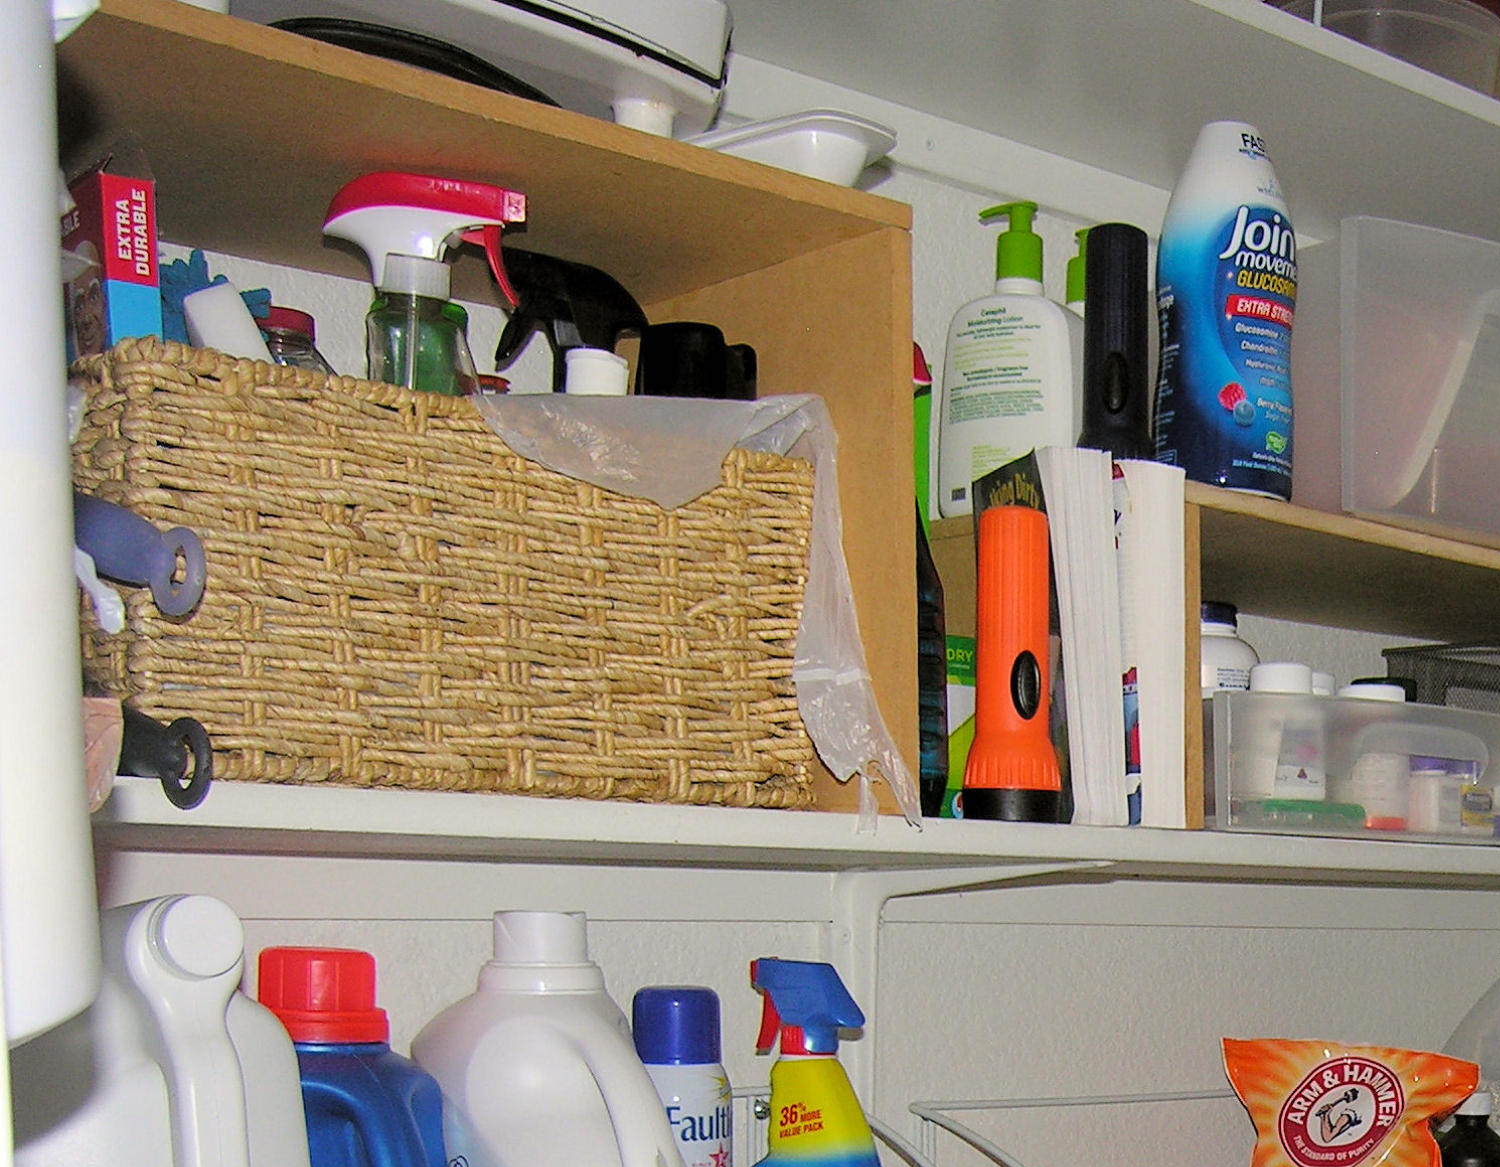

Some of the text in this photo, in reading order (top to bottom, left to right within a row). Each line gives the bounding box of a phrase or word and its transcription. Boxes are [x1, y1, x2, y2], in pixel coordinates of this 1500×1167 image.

[115, 199, 133, 260] EXTRA
[131, 187, 151, 277] DURABLE
[1236, 298, 1271, 315] EXTRA
[1286, 1064, 1397, 1127] ARM & HAMMER
[800, 1109, 822, 1121] MORE
[779, 1120, 825, 1139] VALUE PACK
[1300, 1147, 1336, 1162] STANDARD
[1336, 1150, 1347, 1161] OF
[1347, 1137, 1375, 1160] PURITY
